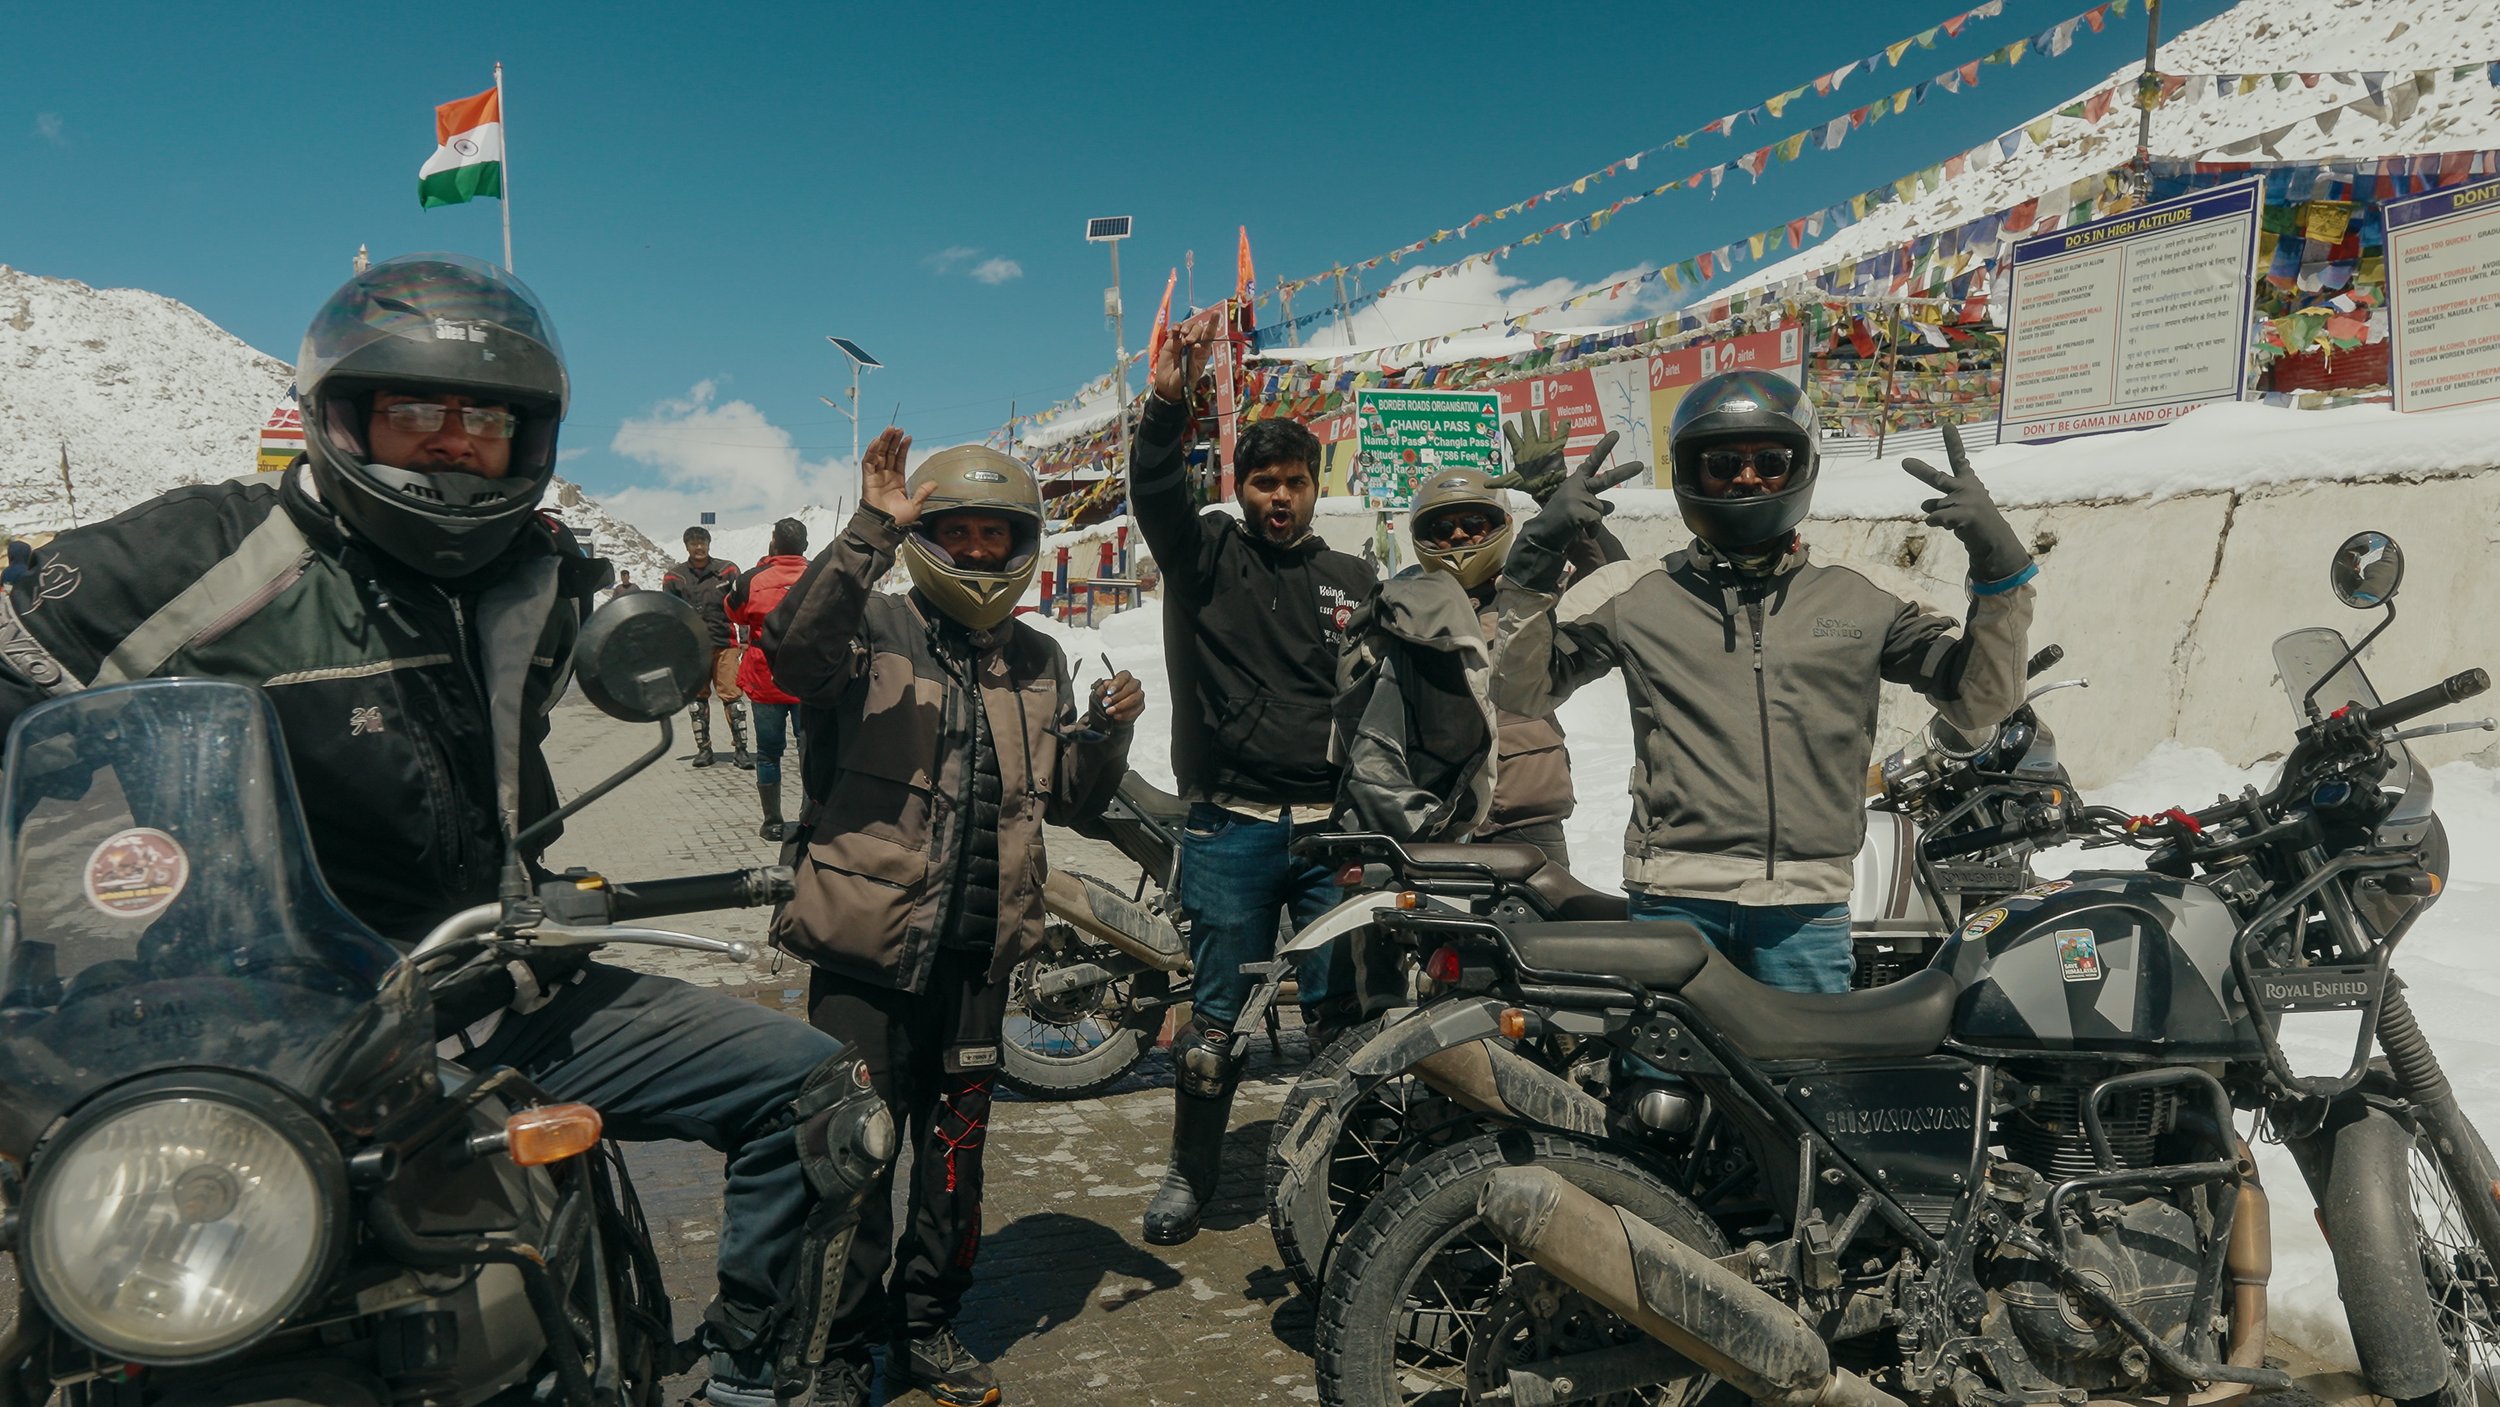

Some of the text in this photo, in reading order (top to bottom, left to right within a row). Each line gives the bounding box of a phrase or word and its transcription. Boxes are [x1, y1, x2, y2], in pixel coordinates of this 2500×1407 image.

[2065, 207, 2192, 247] DO'S IN HIGH ALTITUDE
[2408, 324, 2435, 334] DESCENT
[1378, 399, 1480, 412] BORDER ROADS ORGANISATION
[1556, 403, 1592, 417] Welcome to
[1390, 419, 1471, 432] CHANGLA PASS
[1570, 416, 1597, 429] LADAKH
[2058, 421, 2070, 432] BE
[2073, 417, 2105, 430] GAMA
[2108, 414, 2120, 425] IN
[2123, 411, 2154, 423] LAND
[2157, 408, 2173, 419] OF
[1363, 435, 1389, 445] Name
[1391, 434, 1400, 445] of
[1433, 436, 1468, 449] Changla
[1469, 437, 1490, 447] Pass
[1366, 450, 1399, 460] ltitude
[1460, 451, 1479, 461] Feet
[1366, 464, 1392, 474] World
[1319, 585, 1345, 600] Being
[1813, 628, 1862, 640] ENFIELD
[2265, 981, 2369, 999] ROYAL ENFIELD
